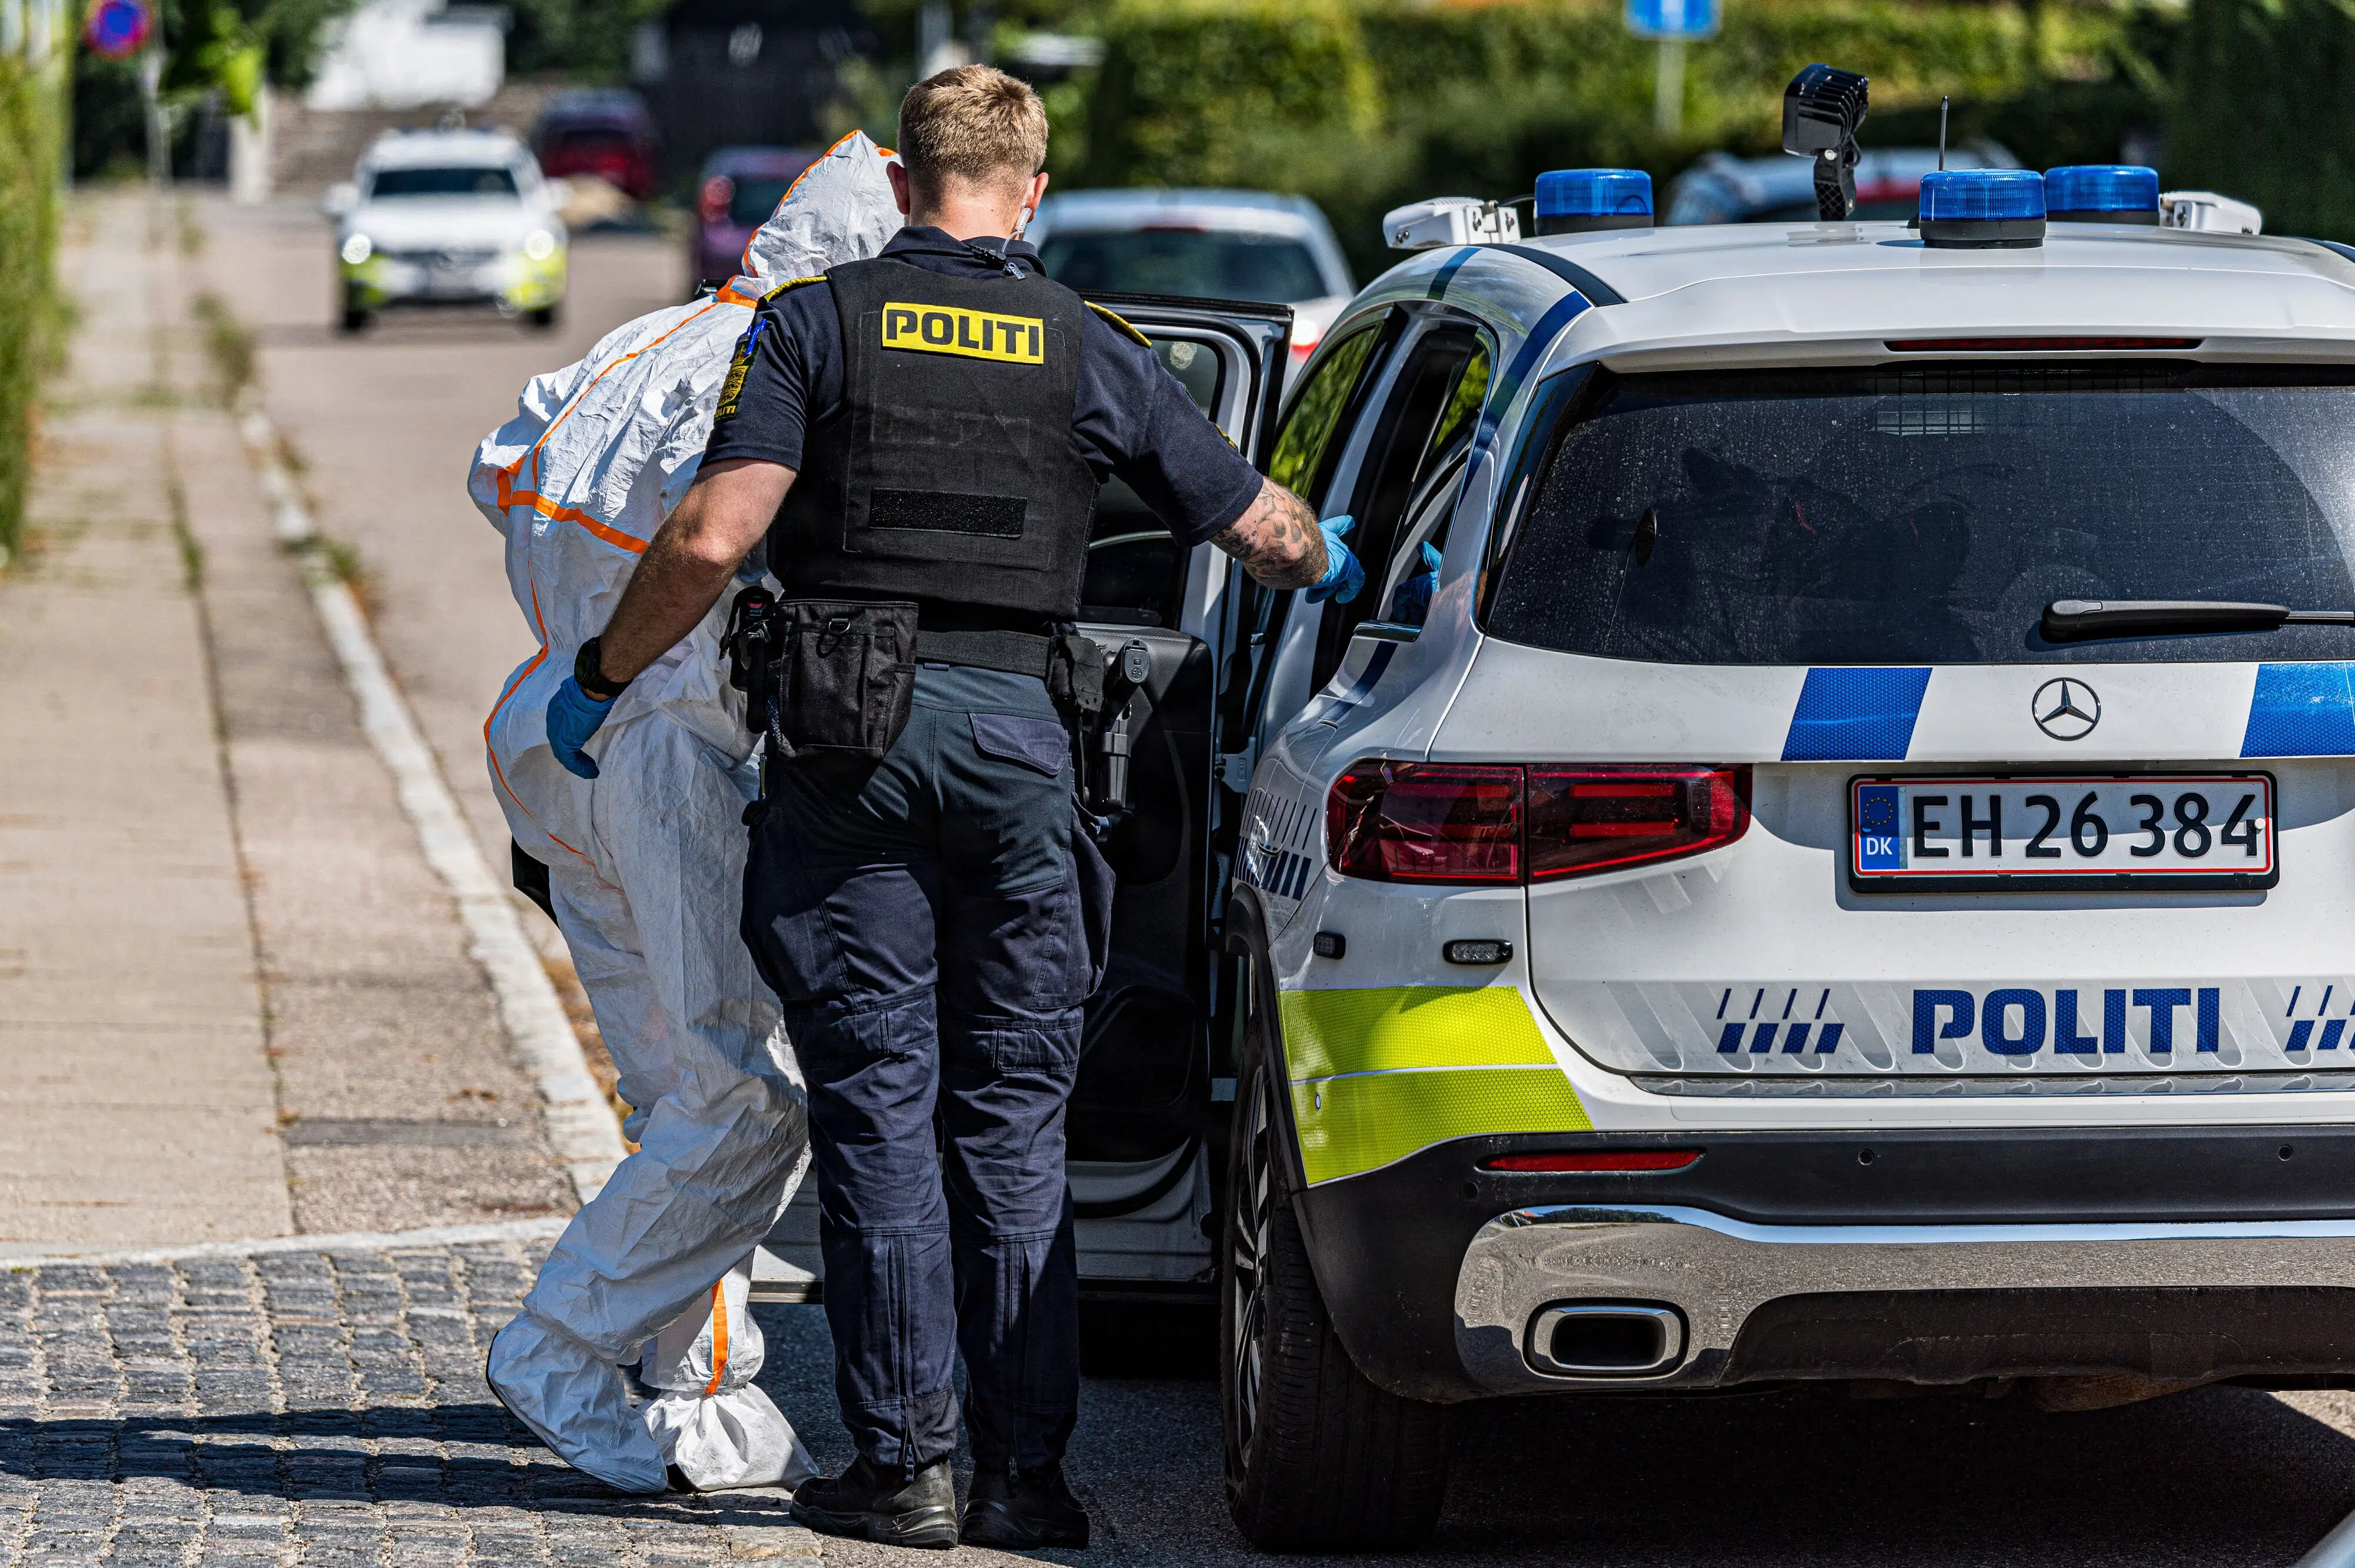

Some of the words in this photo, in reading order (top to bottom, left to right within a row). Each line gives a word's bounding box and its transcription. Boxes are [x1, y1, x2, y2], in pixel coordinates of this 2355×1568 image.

[886, 309, 1040, 357] POLITI
[714, 405, 736, 418] OLITI
[1866, 837, 1893, 855] DK
[1913, 795, 2002, 857] EH
[2025, 790, 2108, 858] 26
[2130, 792, 2257, 858] 384
[1912, 988, 2220, 1055] POLITI
